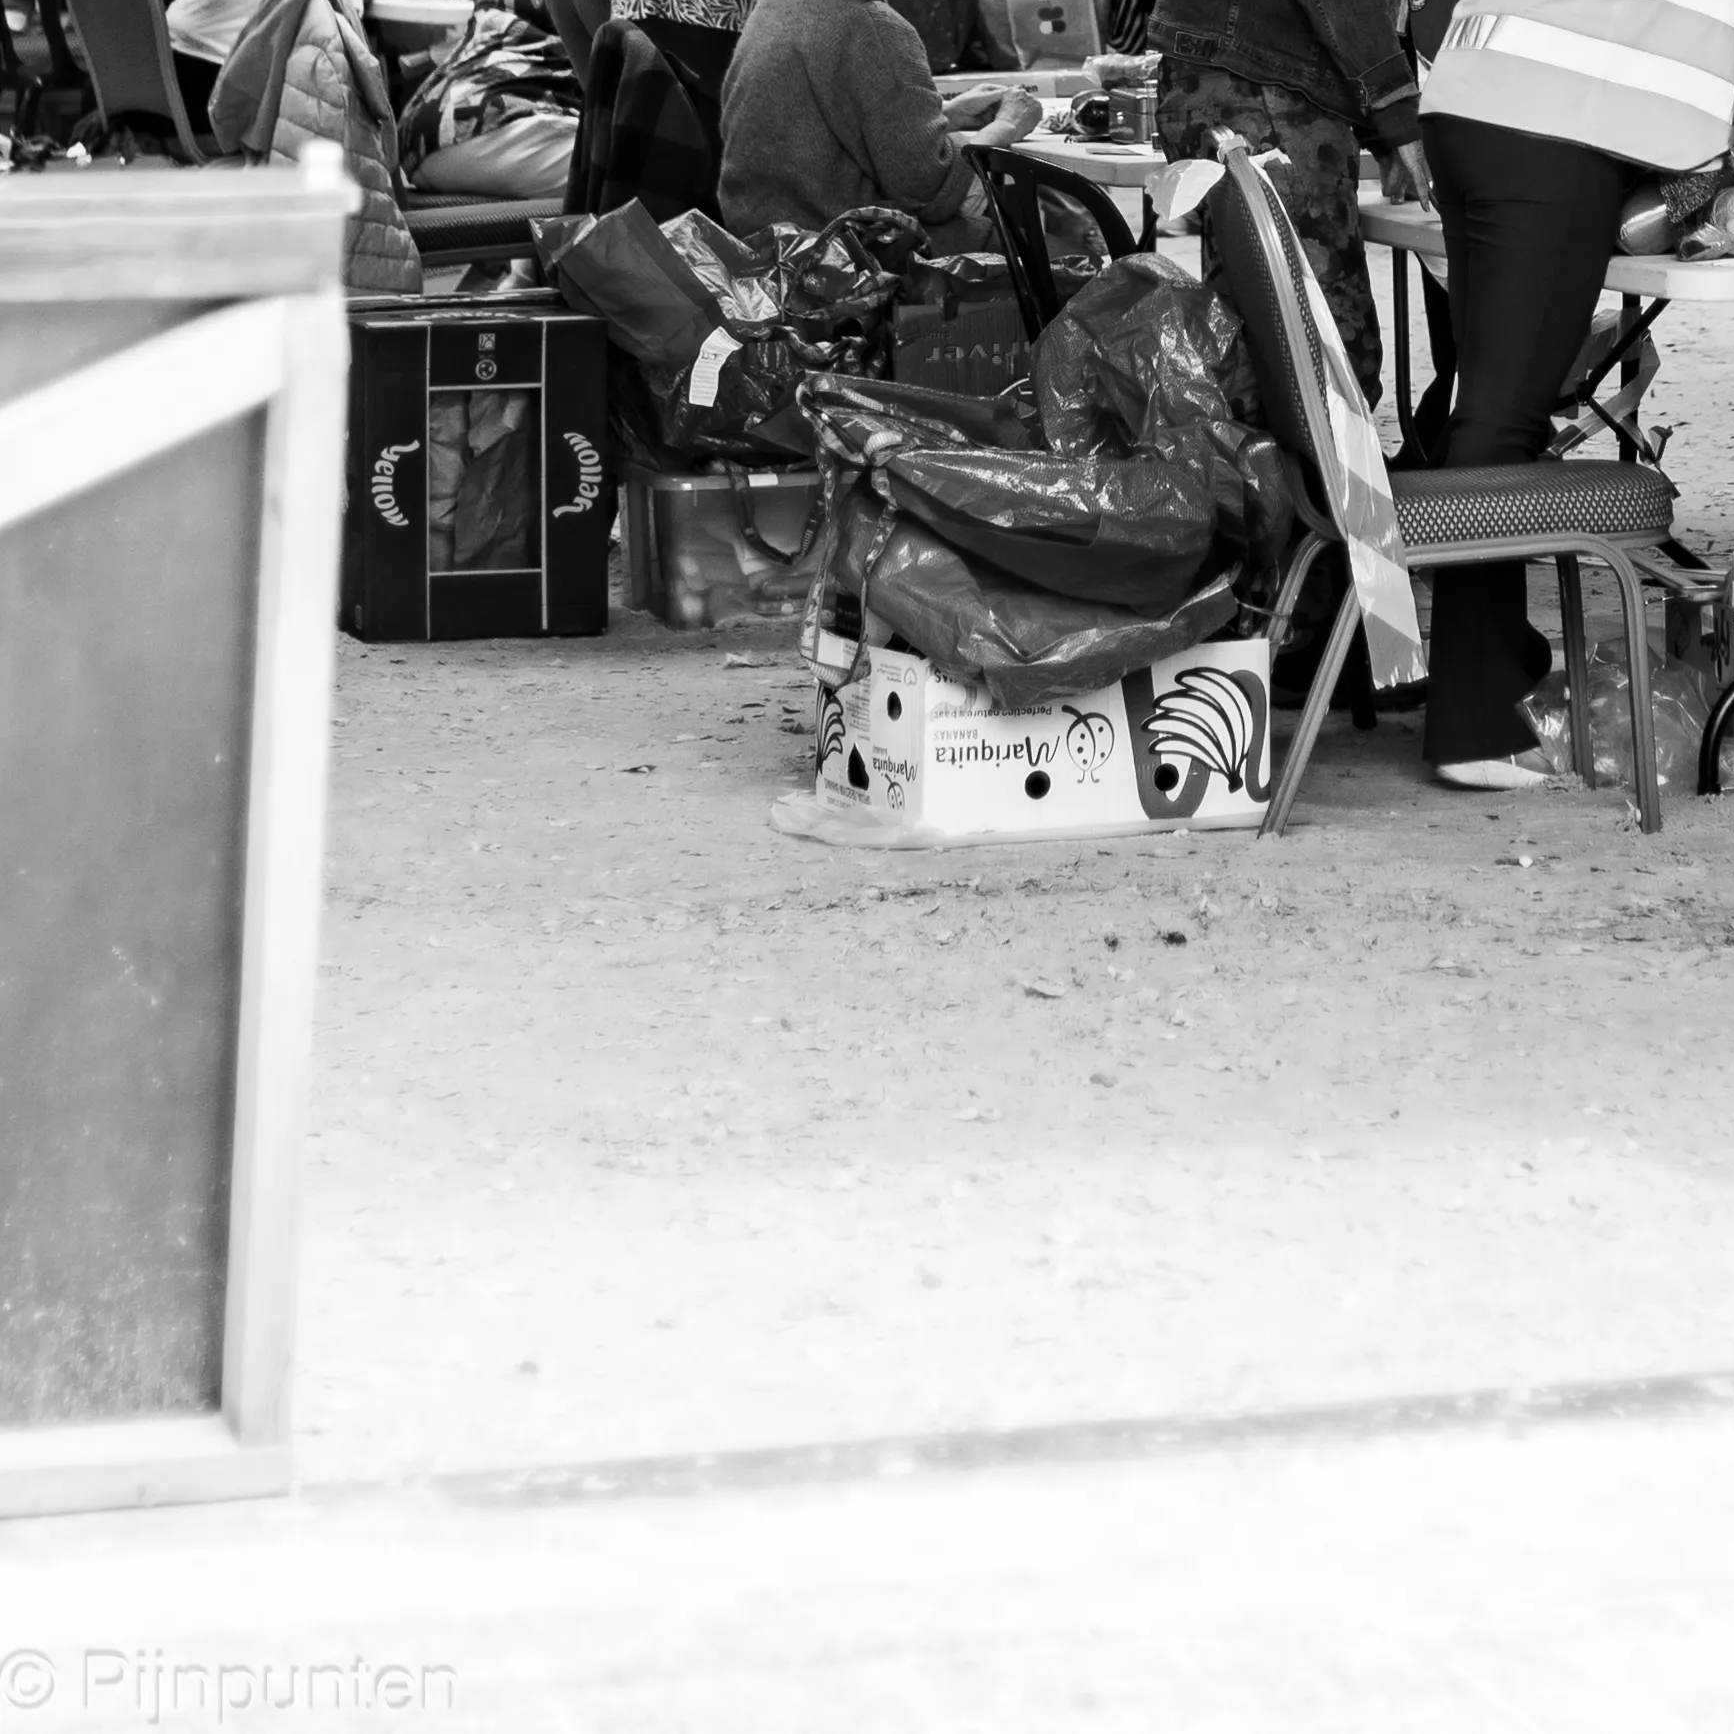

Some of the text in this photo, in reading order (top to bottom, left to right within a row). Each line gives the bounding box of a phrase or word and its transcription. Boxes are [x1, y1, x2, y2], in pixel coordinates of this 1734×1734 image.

[924, 340, 1032, 368] river
[371, 438, 422, 529] yellow
[551, 431, 604, 520] yellow
[934, 735, 1061, 769] Mariquita
[872, 756, 919, 783] Mariquita
